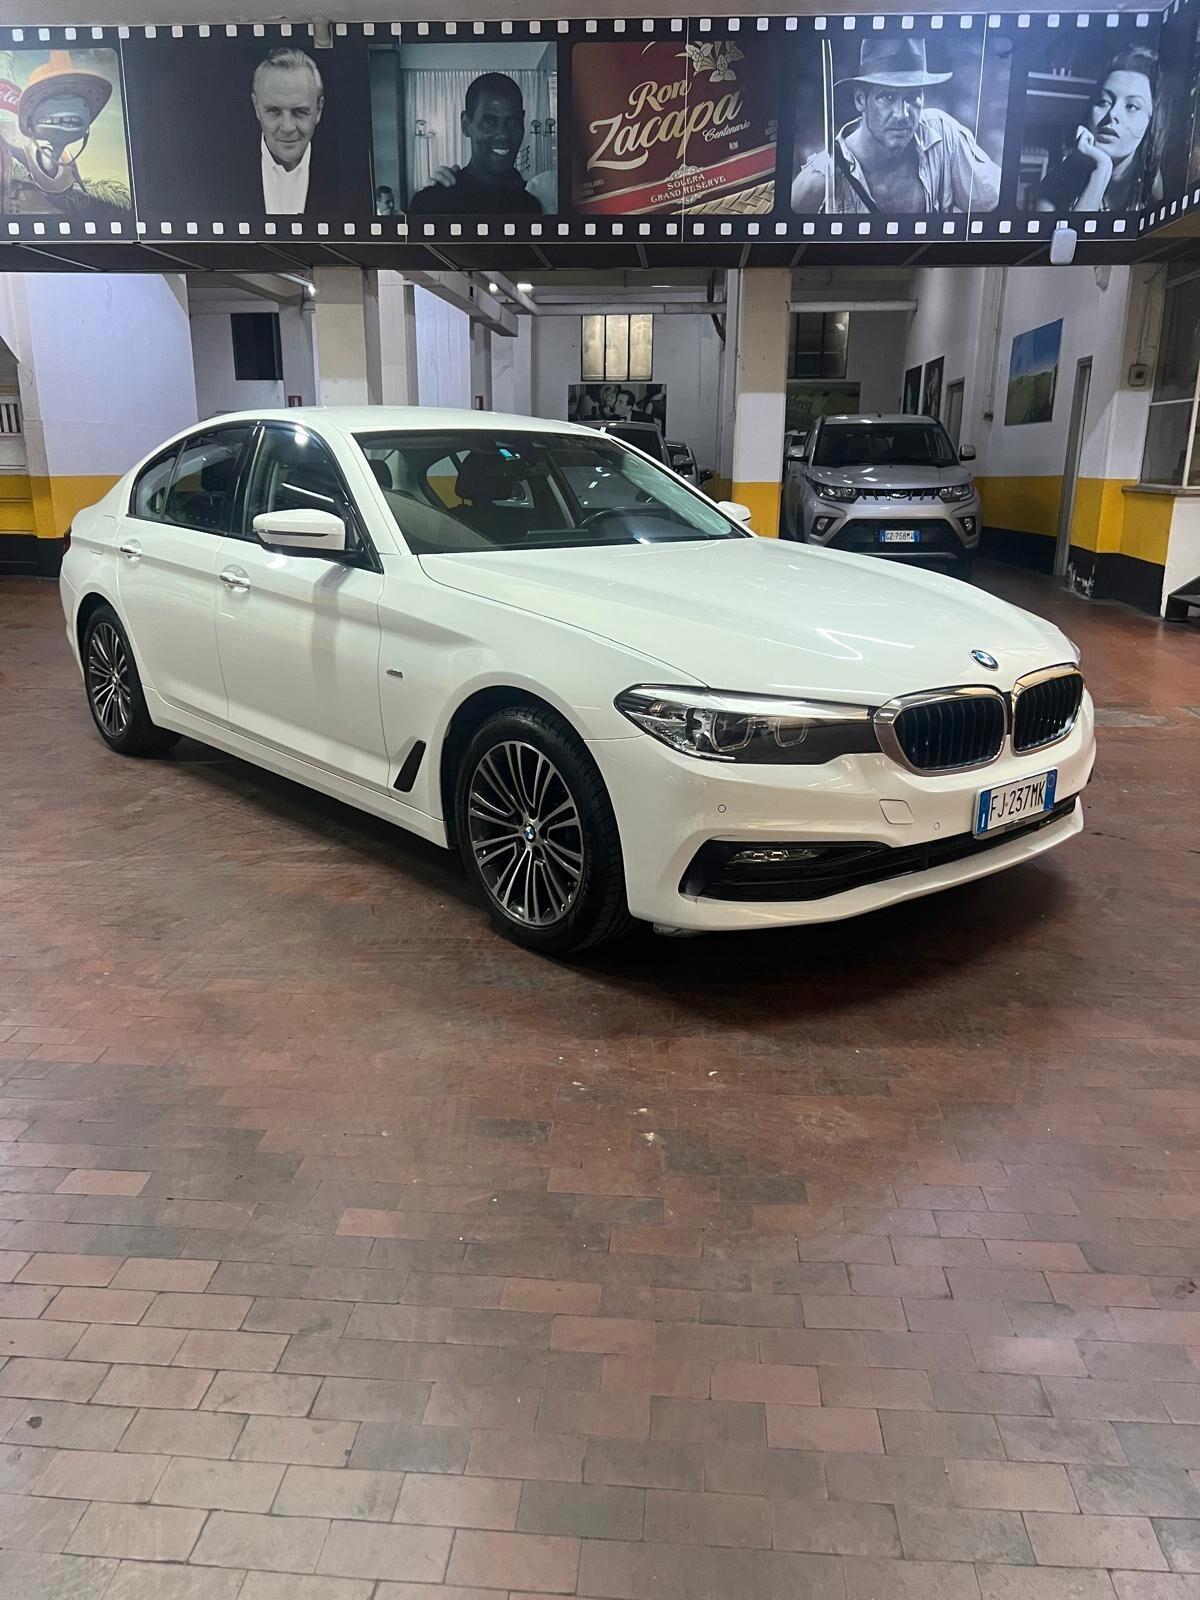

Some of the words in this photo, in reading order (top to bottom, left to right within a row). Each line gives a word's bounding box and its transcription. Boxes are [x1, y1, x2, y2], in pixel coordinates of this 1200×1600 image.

[626, 79, 693, 119] Ron
[586, 90, 744, 172] Zacapa
[702, 120, 751, 142] Centenario
[650, 189, 682, 203] GRAND
[682, 175, 727, 195] RESERVE
[667, 173, 706, 190] SOLERA
